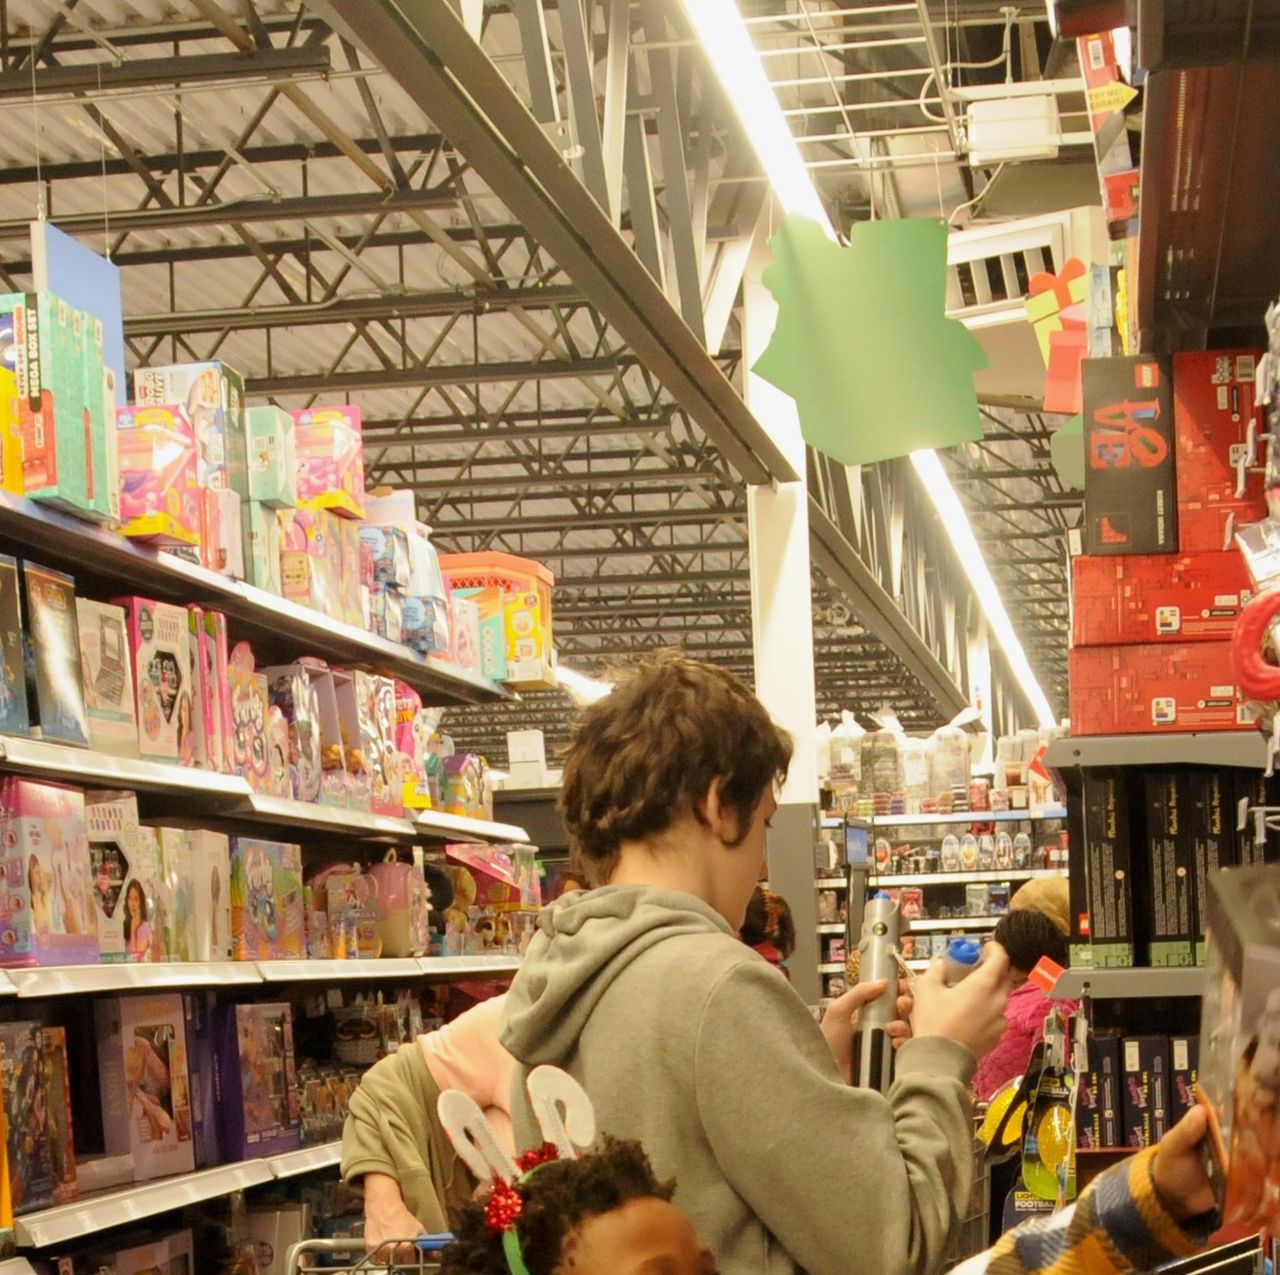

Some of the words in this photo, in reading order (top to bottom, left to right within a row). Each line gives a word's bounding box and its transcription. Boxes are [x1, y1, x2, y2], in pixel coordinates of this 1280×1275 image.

[26, 307, 37, 332] SET
[27, 333, 38, 360] BOX
[29, 360, 40, 398] MEGA
